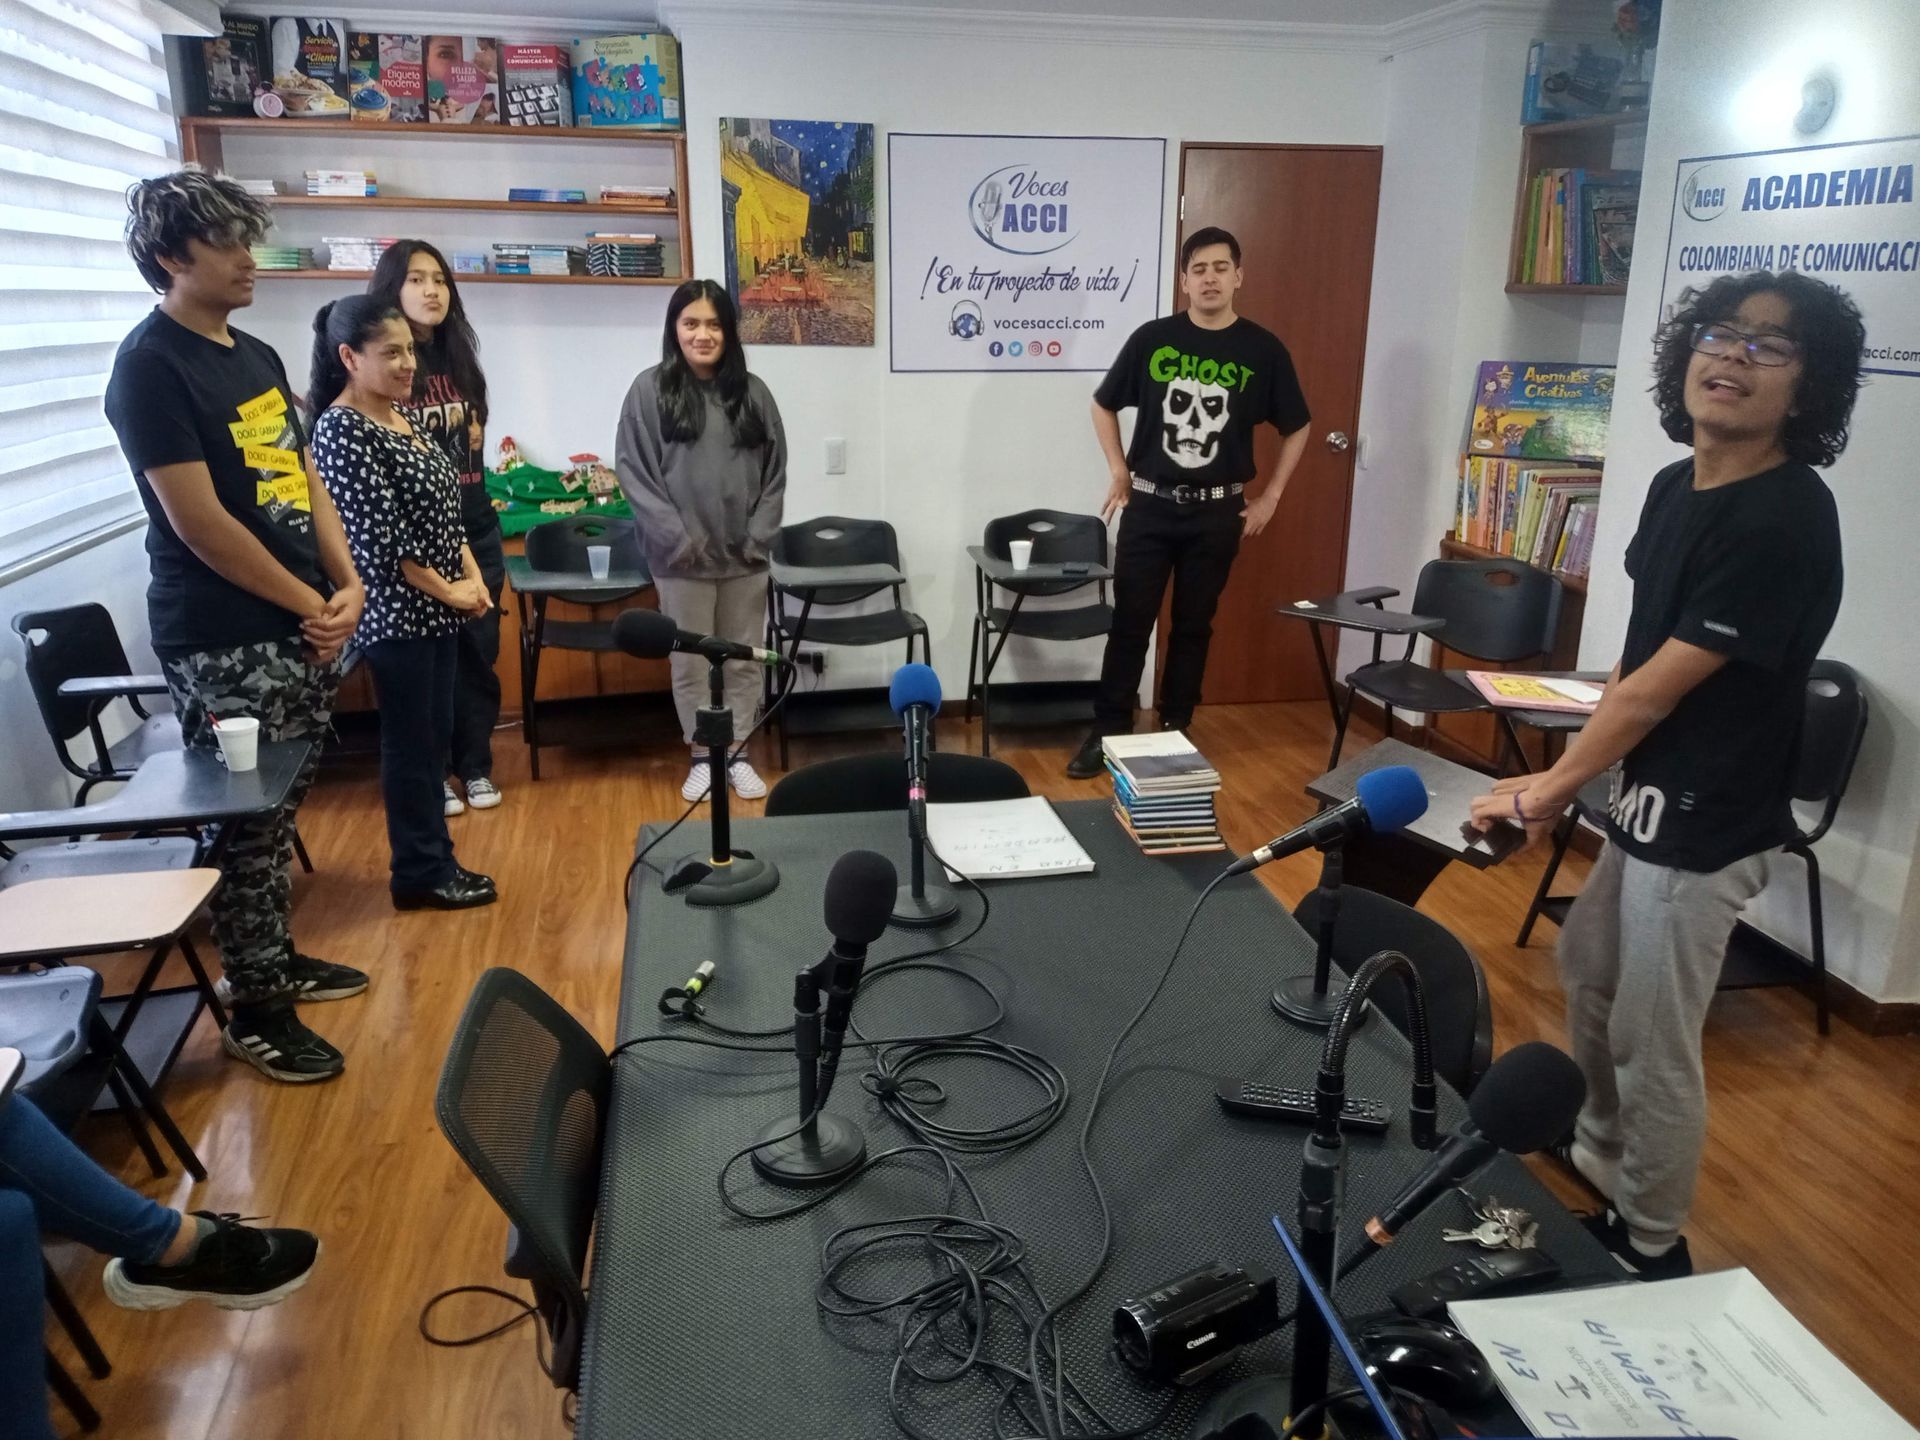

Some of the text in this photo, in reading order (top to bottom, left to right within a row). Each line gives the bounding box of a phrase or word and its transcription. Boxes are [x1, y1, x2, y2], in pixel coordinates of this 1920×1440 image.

[310, 53, 338, 63] Cliente
[451, 66, 477, 75] BELLEZA
[506, 57, 554, 65] COMUNICACIÓN
[382, 79, 421, 89] moderna
[1008, 171, 1069, 199] Voces
[1694, 164, 1914, 212] ACCI ACADEMIA
[1001, 203, 1068, 233] ACCI
[1679, 245, 1774, 272] COLOMBIANA
[1778, 244, 1799, 271] DE
[967, 266, 985, 291] tu
[1058, 266, 1081, 291] de
[993, 316, 1105, 331] vocesacci.com
[1149, 345, 1255, 393] GHOST
[1524, 384, 1583, 399] Creativas
[1186, 1331, 1217, 1350] Canon
[1491, 1339, 1541, 1382] EN
[1592, 1358, 1641, 1411] ASERTIVA
